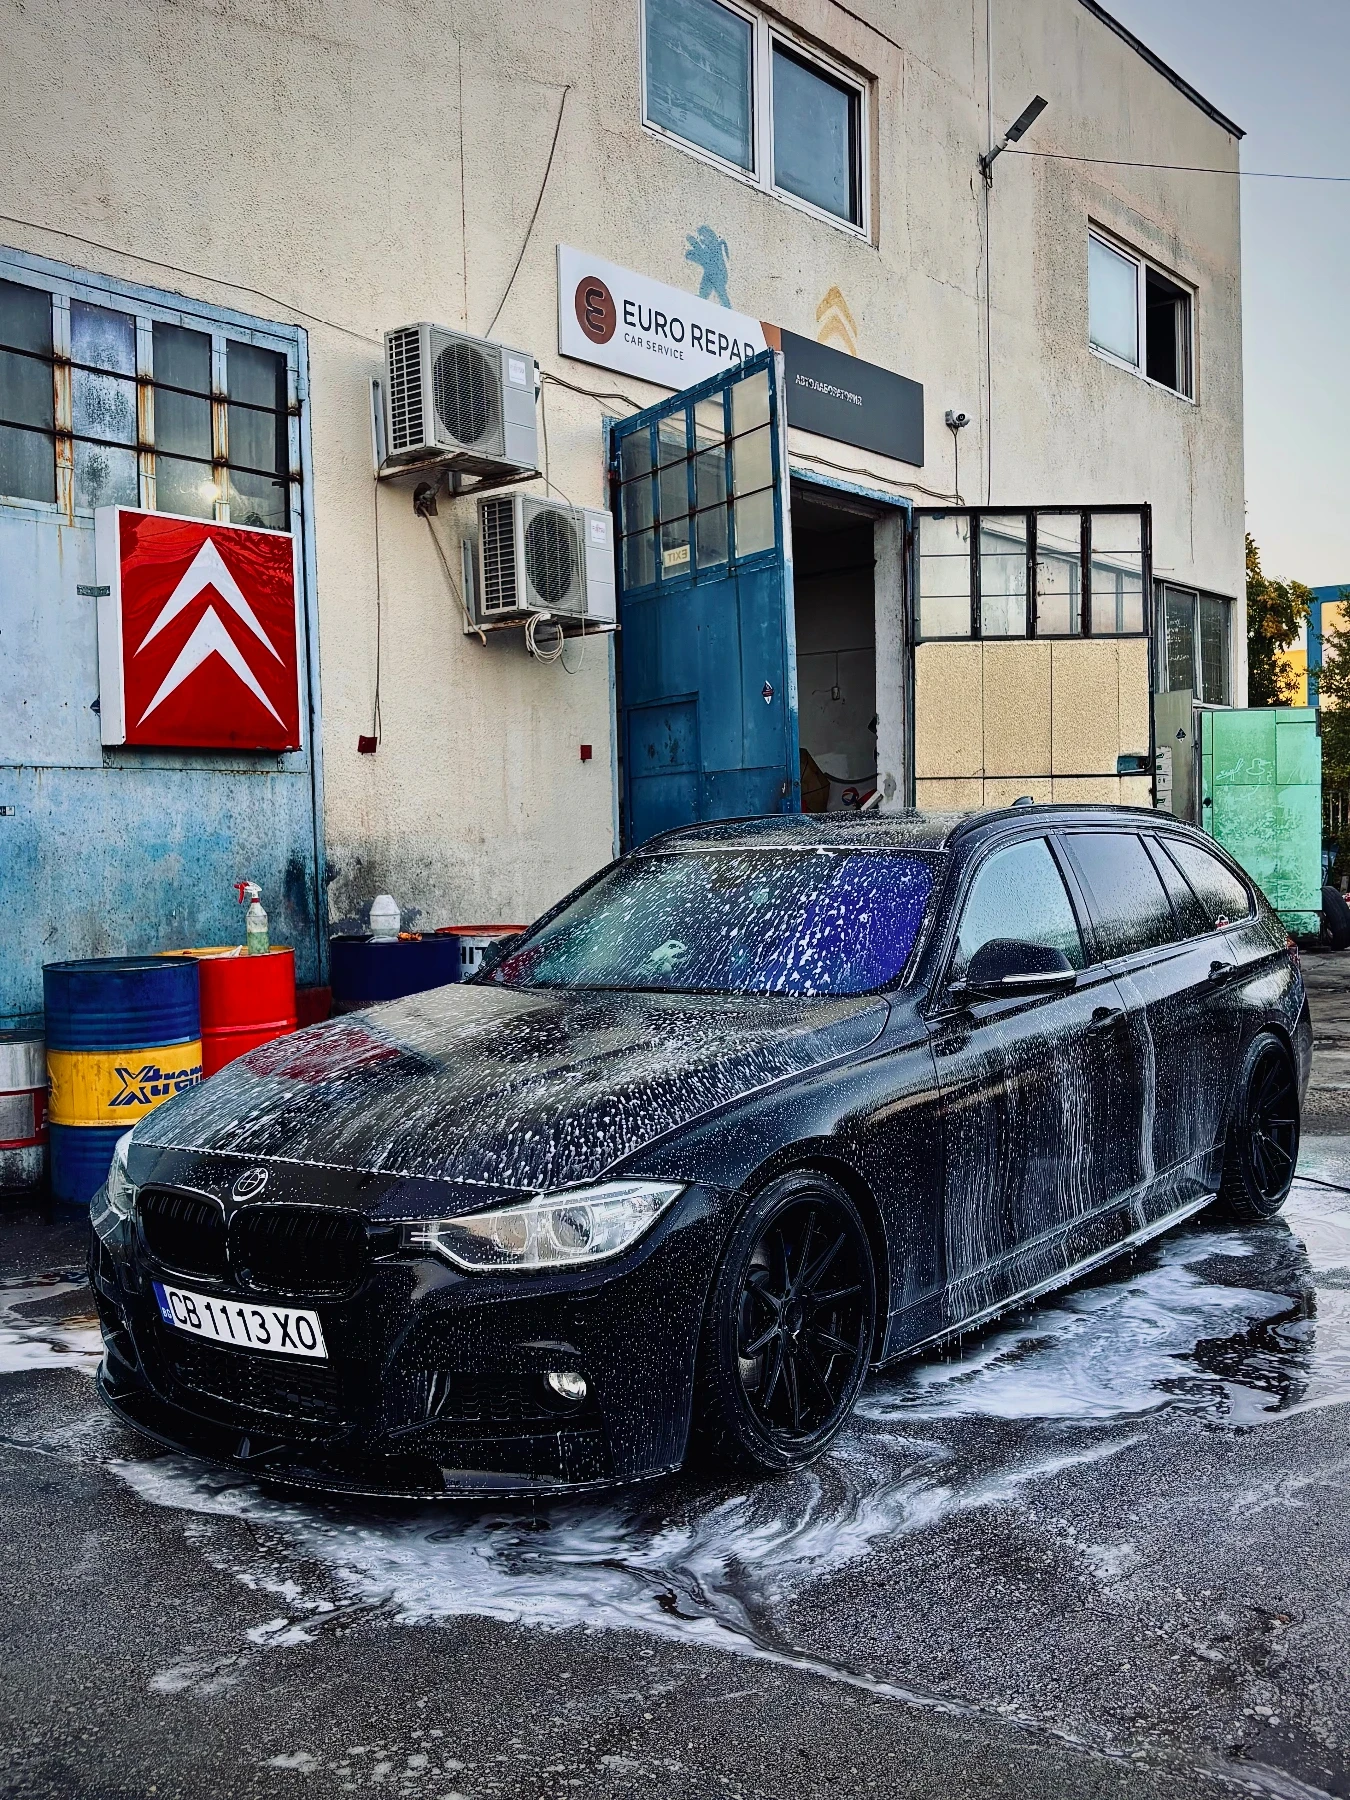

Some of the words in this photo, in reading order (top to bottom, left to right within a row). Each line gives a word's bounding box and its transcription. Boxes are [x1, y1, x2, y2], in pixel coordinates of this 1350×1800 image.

[623, 299, 685, 343] EURO
[624, 332, 643, 347] CAR
[646, 340, 684, 361] SERVICE
[161, 1306, 173, 1319] BG
